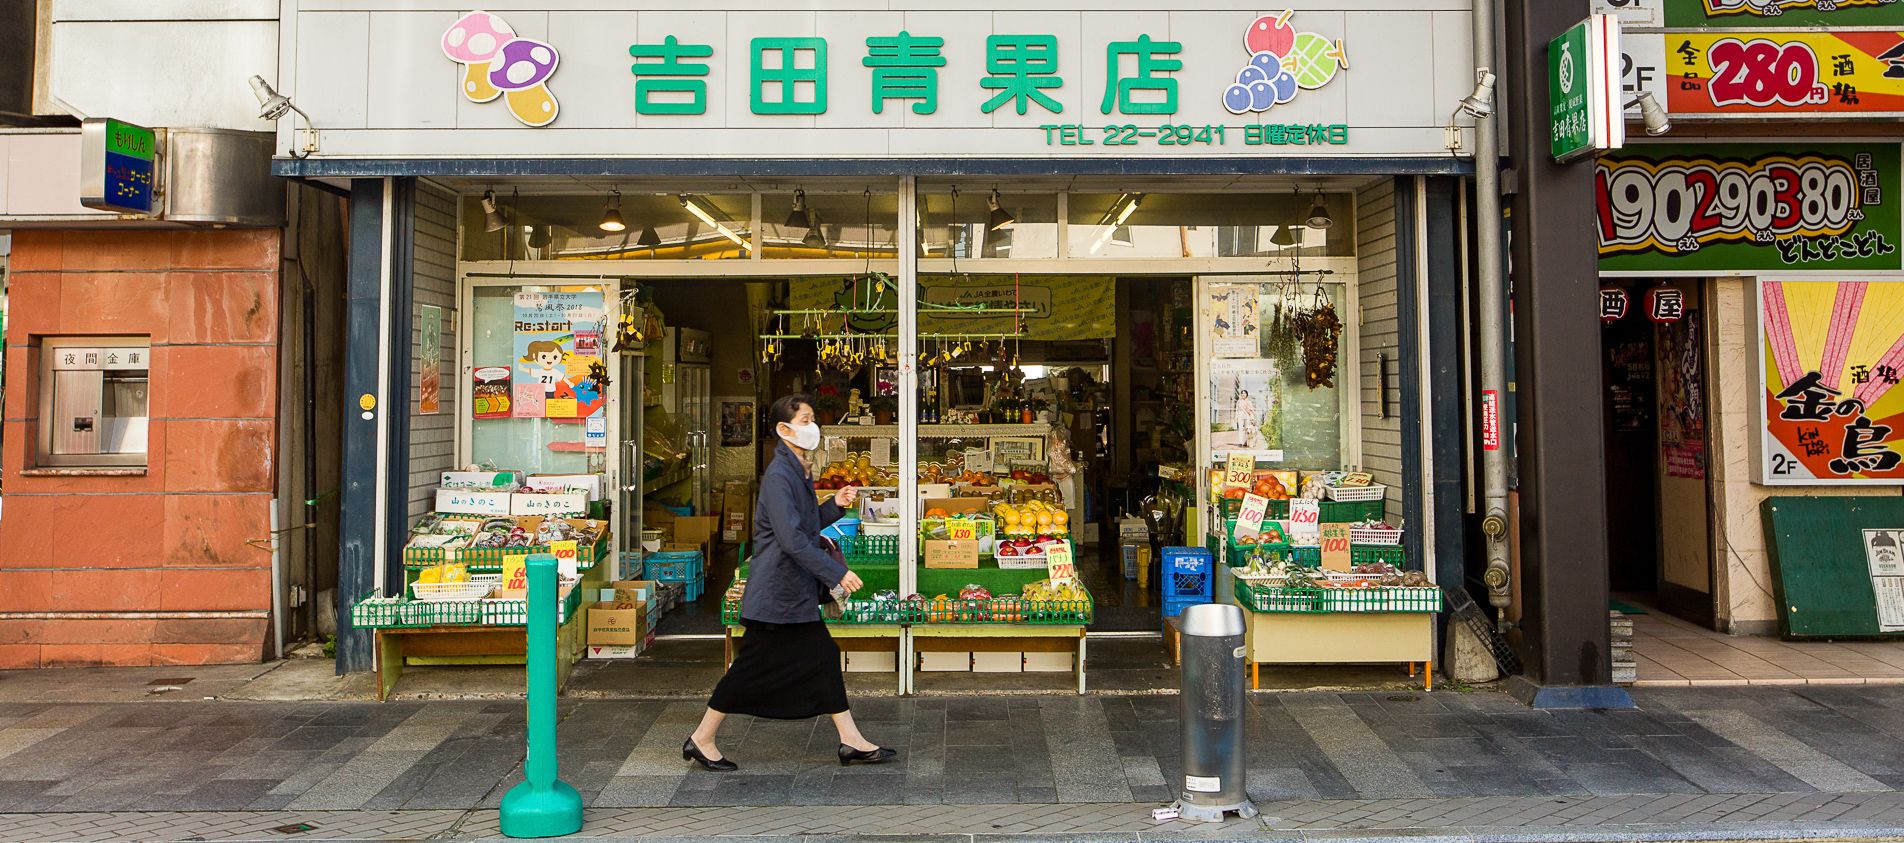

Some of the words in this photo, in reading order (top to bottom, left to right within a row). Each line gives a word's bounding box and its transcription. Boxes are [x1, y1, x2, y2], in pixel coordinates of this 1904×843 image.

[629, 31, 1183, 115] 吉田青果店
[1677, 40, 1700, 91] 全品
[1831, 54, 1859, 105] 酒場
[1039, 124, 1095, 145] TEL
[1102, 124, 1225, 145] 22-2941
[1244, 123, 1349, 146] 日曜定休日
[1552, 110, 1587, 142] 吉田青果店
[115, 130, 145, 154] もりしん
[1855, 153, 1881, 205] 居酒屋
[1775, 230, 1895, 264] どんどこどん
[64, 352, 140, 366] 夜間金庫
[541, 375, 553, 384] 21
[1849, 364, 1899, 386] 酒場
[1771, 453, 1798, 475] 2F
[1229, 470, 1251, 484] 300
[451, 496, 496, 507] 山のきのこ
[526, 499, 570, 509] 山のきのこ
[555, 549, 575, 559] 100
[1323, 537, 1348, 553] 100
